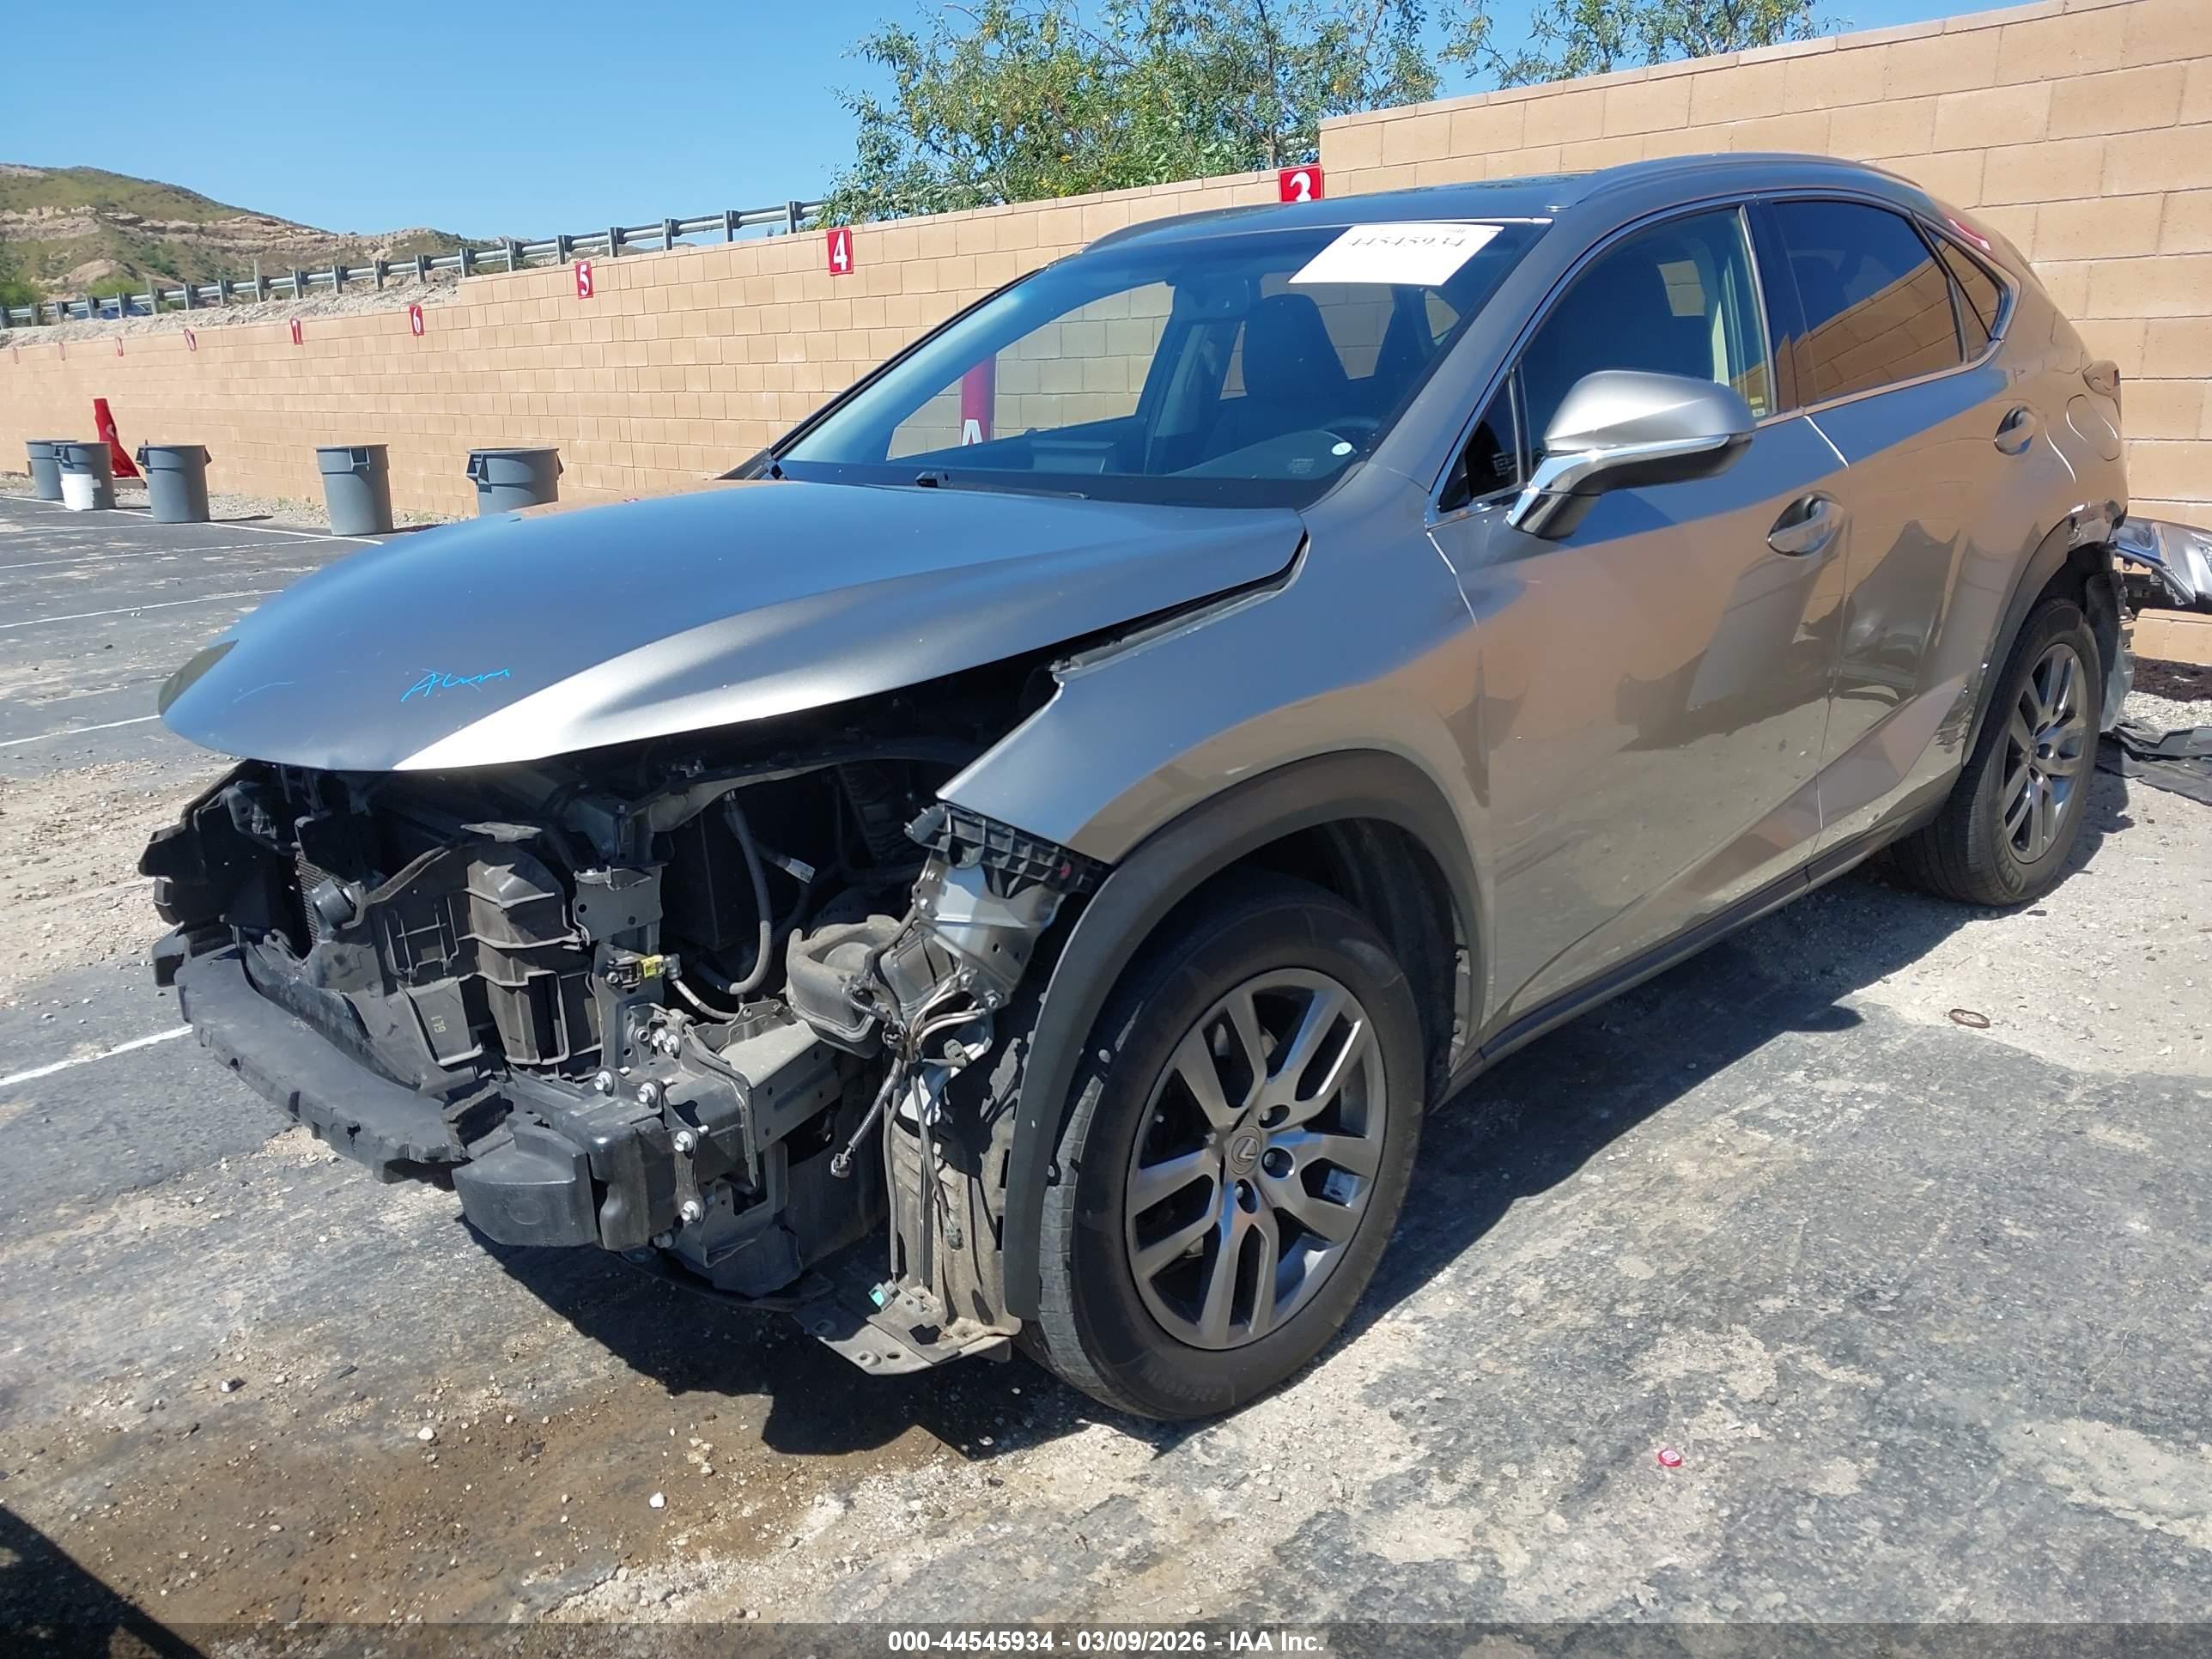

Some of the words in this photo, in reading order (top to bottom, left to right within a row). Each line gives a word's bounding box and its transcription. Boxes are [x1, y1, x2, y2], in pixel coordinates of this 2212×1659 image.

[1290, 172, 1311, 202] 3
[833, 231, 848, 270] 4
[580, 264, 590, 295] 5
[413, 307, 421, 333] 6
